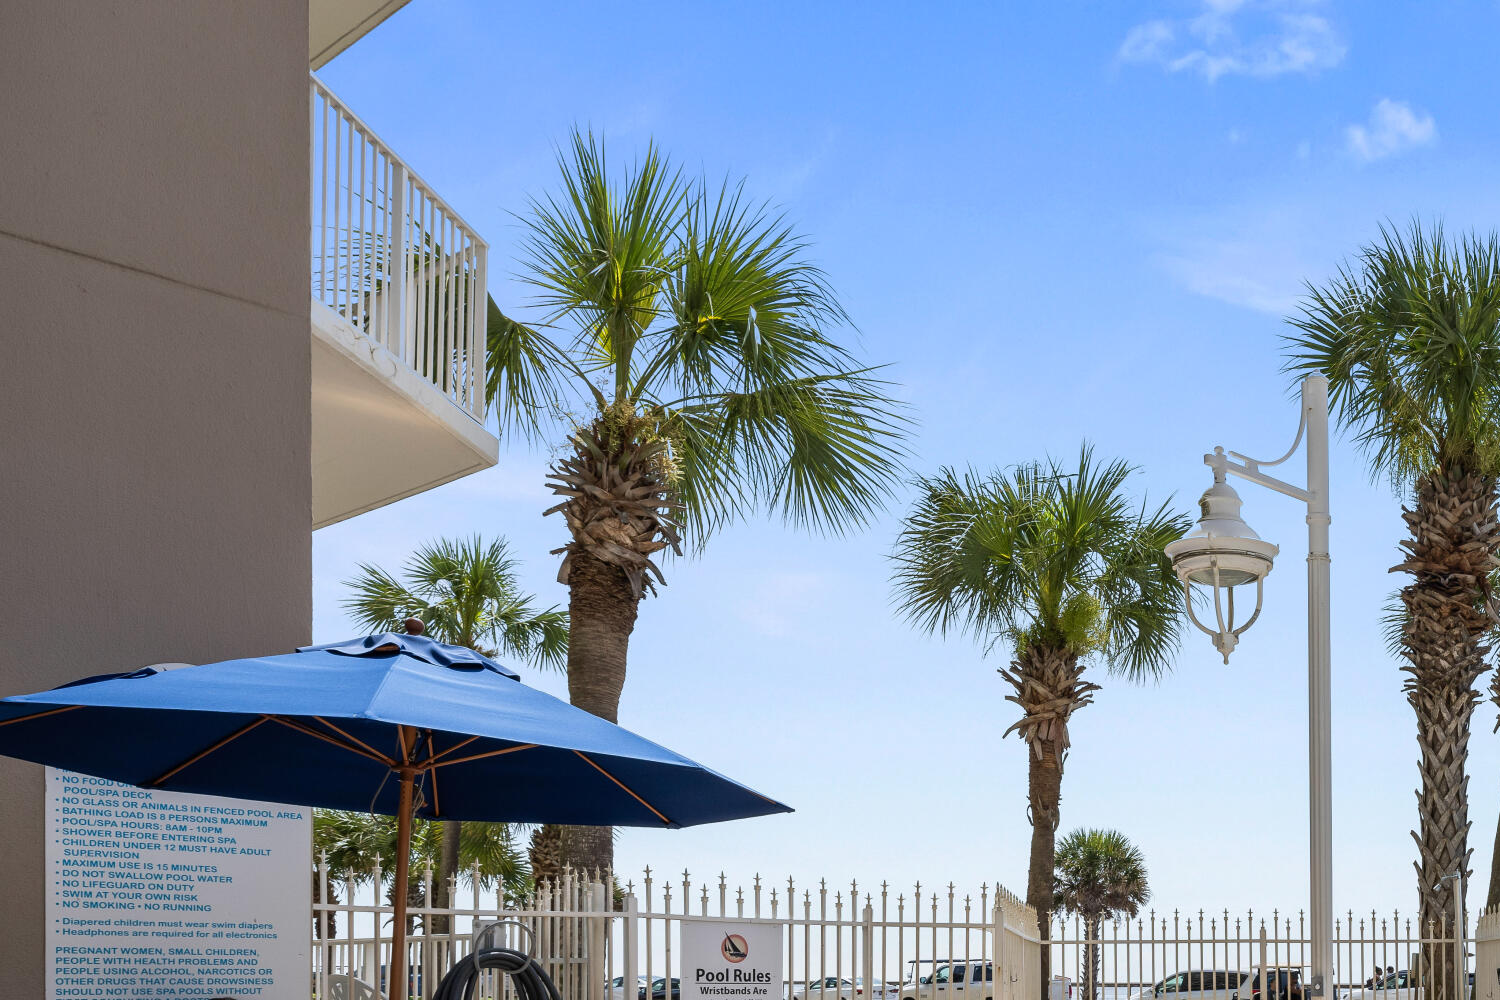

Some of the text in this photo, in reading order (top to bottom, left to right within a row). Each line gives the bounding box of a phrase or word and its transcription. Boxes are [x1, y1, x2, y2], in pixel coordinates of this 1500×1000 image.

[82, 778, 114, 788] FOOD
[64, 787, 152, 799] POOL/SPA DECK
[82, 798, 118, 808] GLASS
[141, 802, 187, 812] ANIMALS
[203, 807, 244, 816] FENCED
[247, 810, 274, 818] POOL
[276, 811, 302, 820] AREA
[62, 807, 111, 818] BATHING
[169, 814, 218, 824] PERSONS
[220, 818, 268, 827] MAXIMUM
[62, 818, 117, 828] POOL/SPA
[121, 821, 162, 830] HOURS:
[62, 828, 111, 838] SHOWER
[115, 831, 158, 840] BEFORE
[162, 832, 214, 843] ENTERING
[62, 839, 120, 848] CHILDREN
[123, 841, 160, 850] UNDER
[64, 849, 139, 859] SUPERVISION
[62, 860, 115, 868] MAXIMUM
[108, 871, 163, 880] SWALLOW
[82, 881, 146, 890] LIFEGUARD
[82, 901, 135, 910] SMOKING
[163, 904, 211, 912] RUNNING
[62, 918, 111, 928] Diapered
[114, 918, 156, 927] children
[238, 922, 272, 930] diapers
[62, 929, 129, 938] Headphones
[155, 929, 194, 939] required
[226, 931, 277, 939] electronics
[55, 946, 118, 955] PREGNANT
[121, 947, 166, 956] WOMEN,
[206, 948, 260, 957] CHILDREN,
[141, 968, 195, 976] ALCOHOL,
[696, 968, 770, 982] Pool Rules
[55, 988, 103, 996] SHOULD
